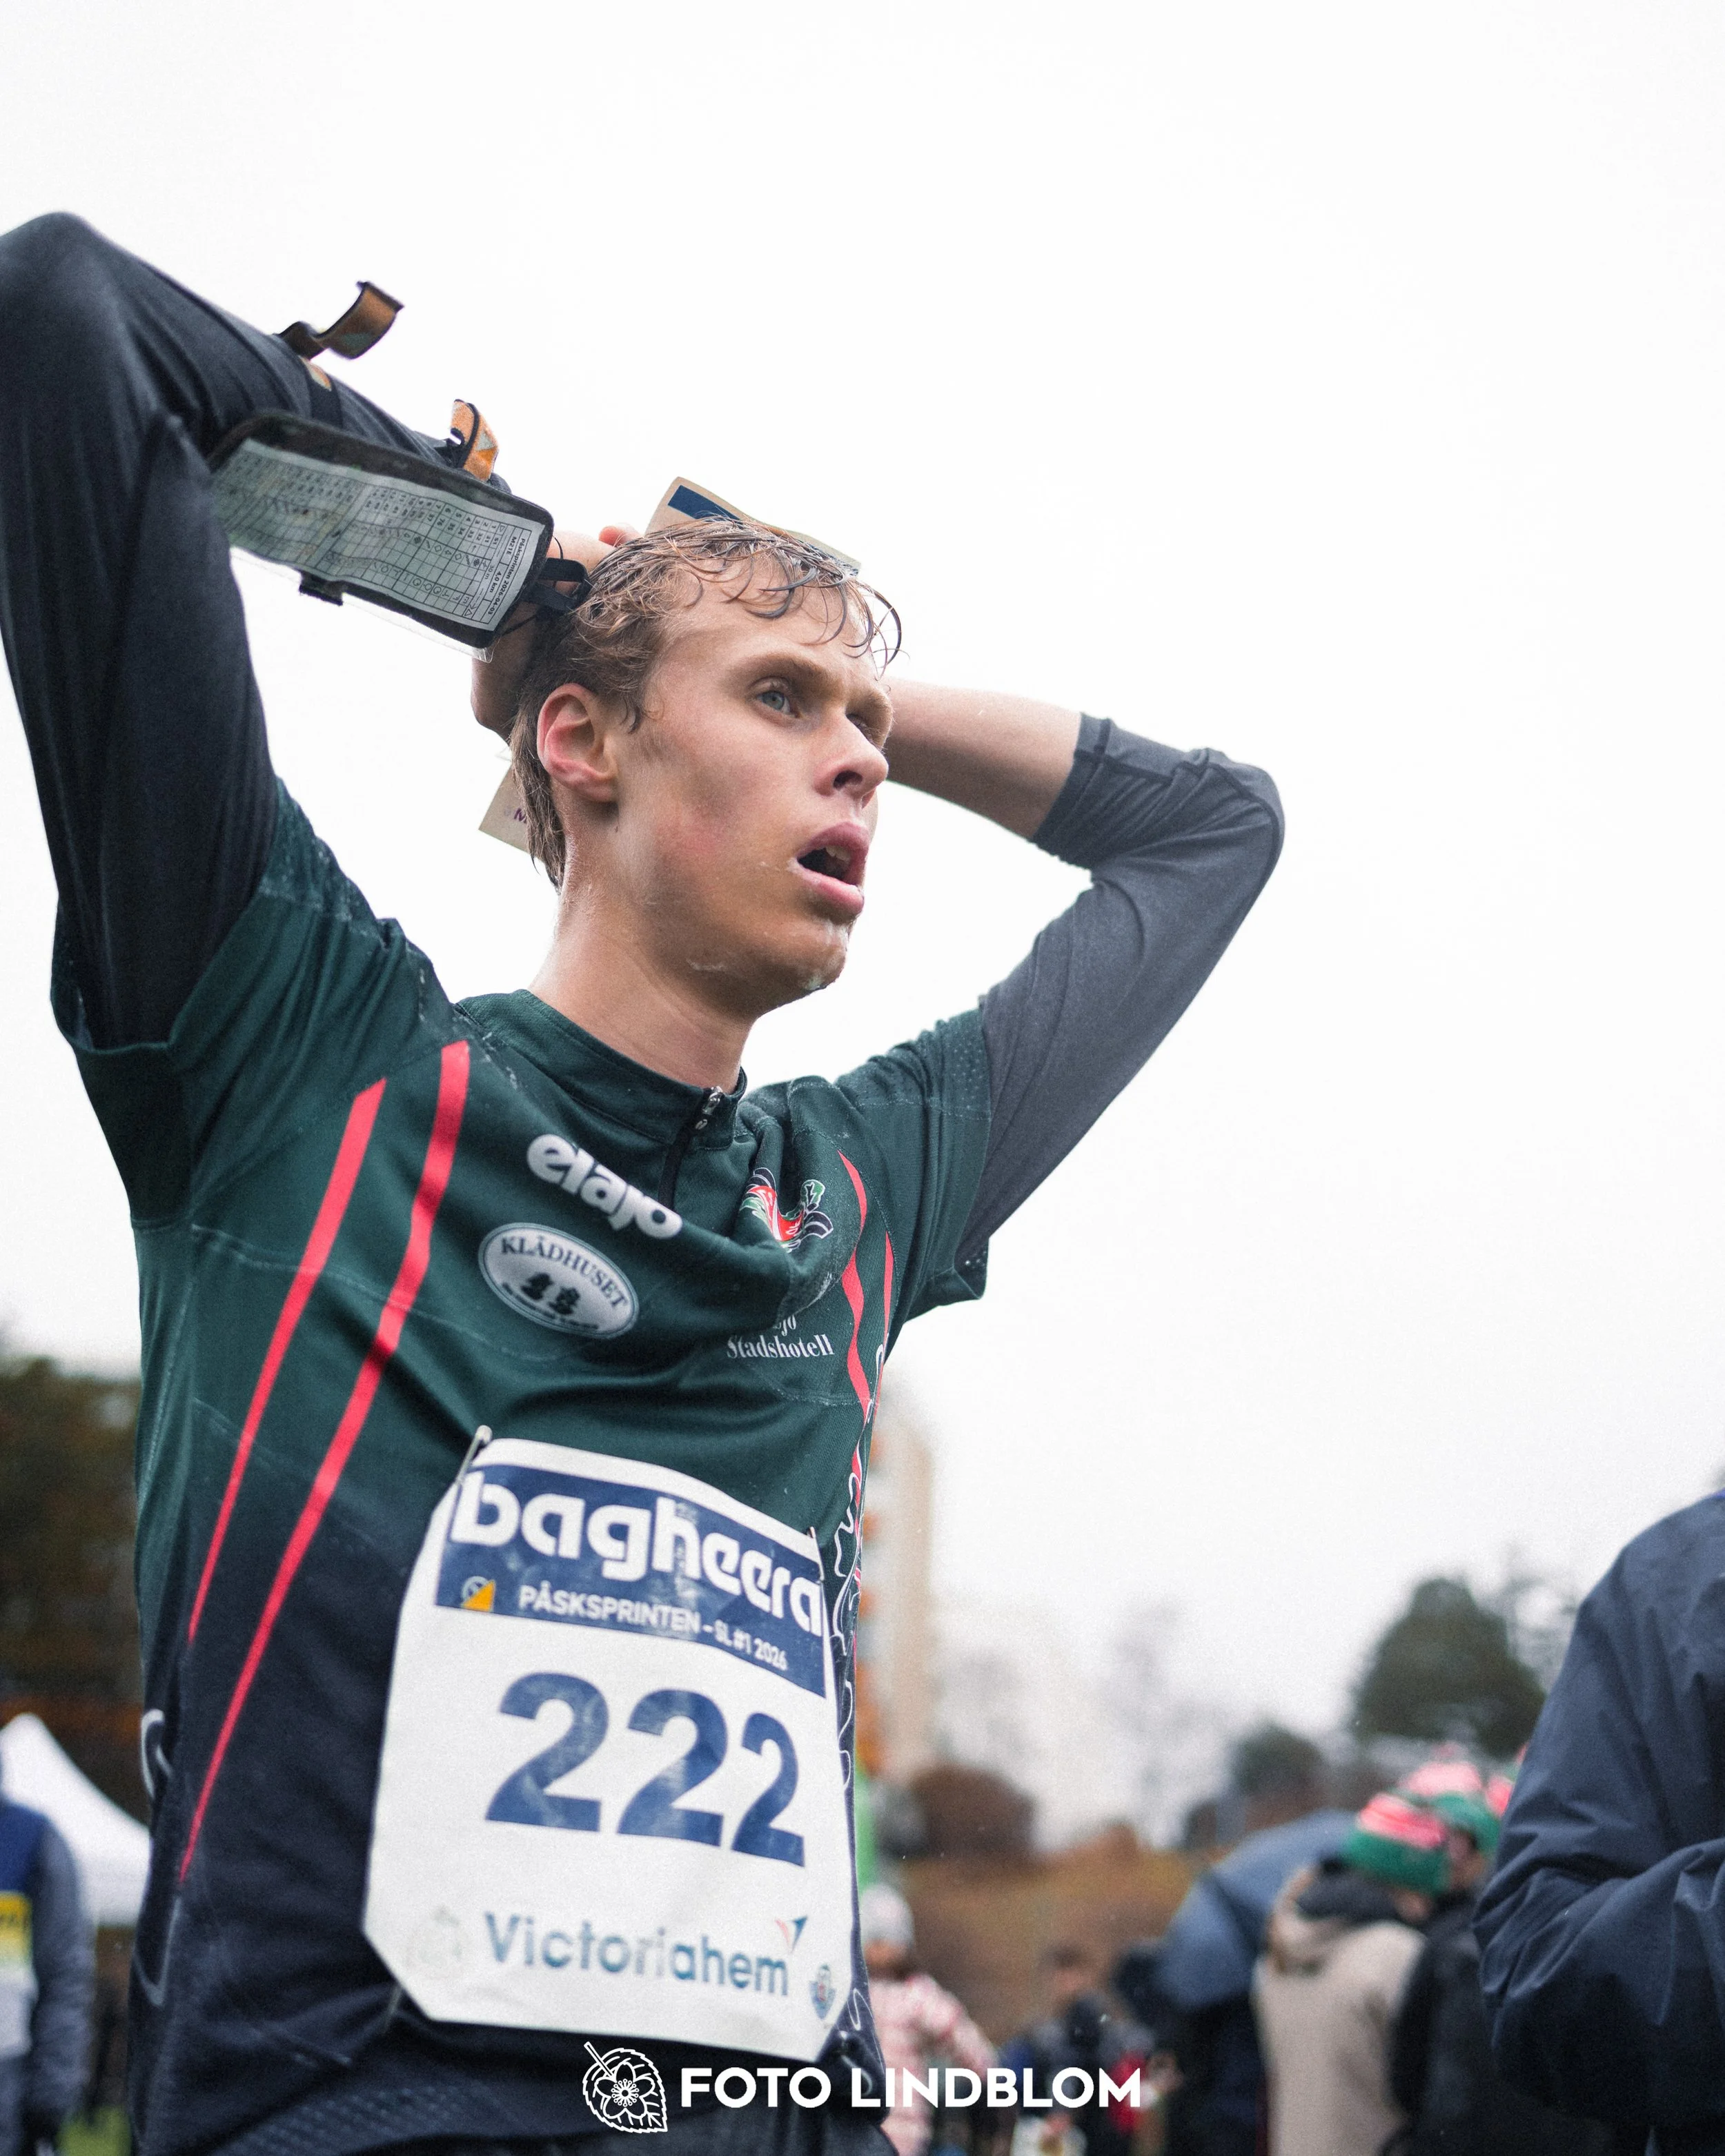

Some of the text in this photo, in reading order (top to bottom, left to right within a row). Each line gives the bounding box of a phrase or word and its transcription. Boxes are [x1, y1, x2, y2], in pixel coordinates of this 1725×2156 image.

[487, 537, 526, 615] Påsksprinten 2026-04-03
[489, 582, 497, 593] km
[506, 536, 517, 555] M21E
[526, 1134, 683, 1239] elajo
[727, 1334, 836, 1359] Stadshotell
[450, 1471, 822, 1636] bagheera
[518, 1579, 701, 1634] PÅSKSPRINTEN
[753, 1637, 789, 1672] 2026
[485, 1672, 805, 1868] 222
[484, 1911, 789, 1996] Victoriahem
